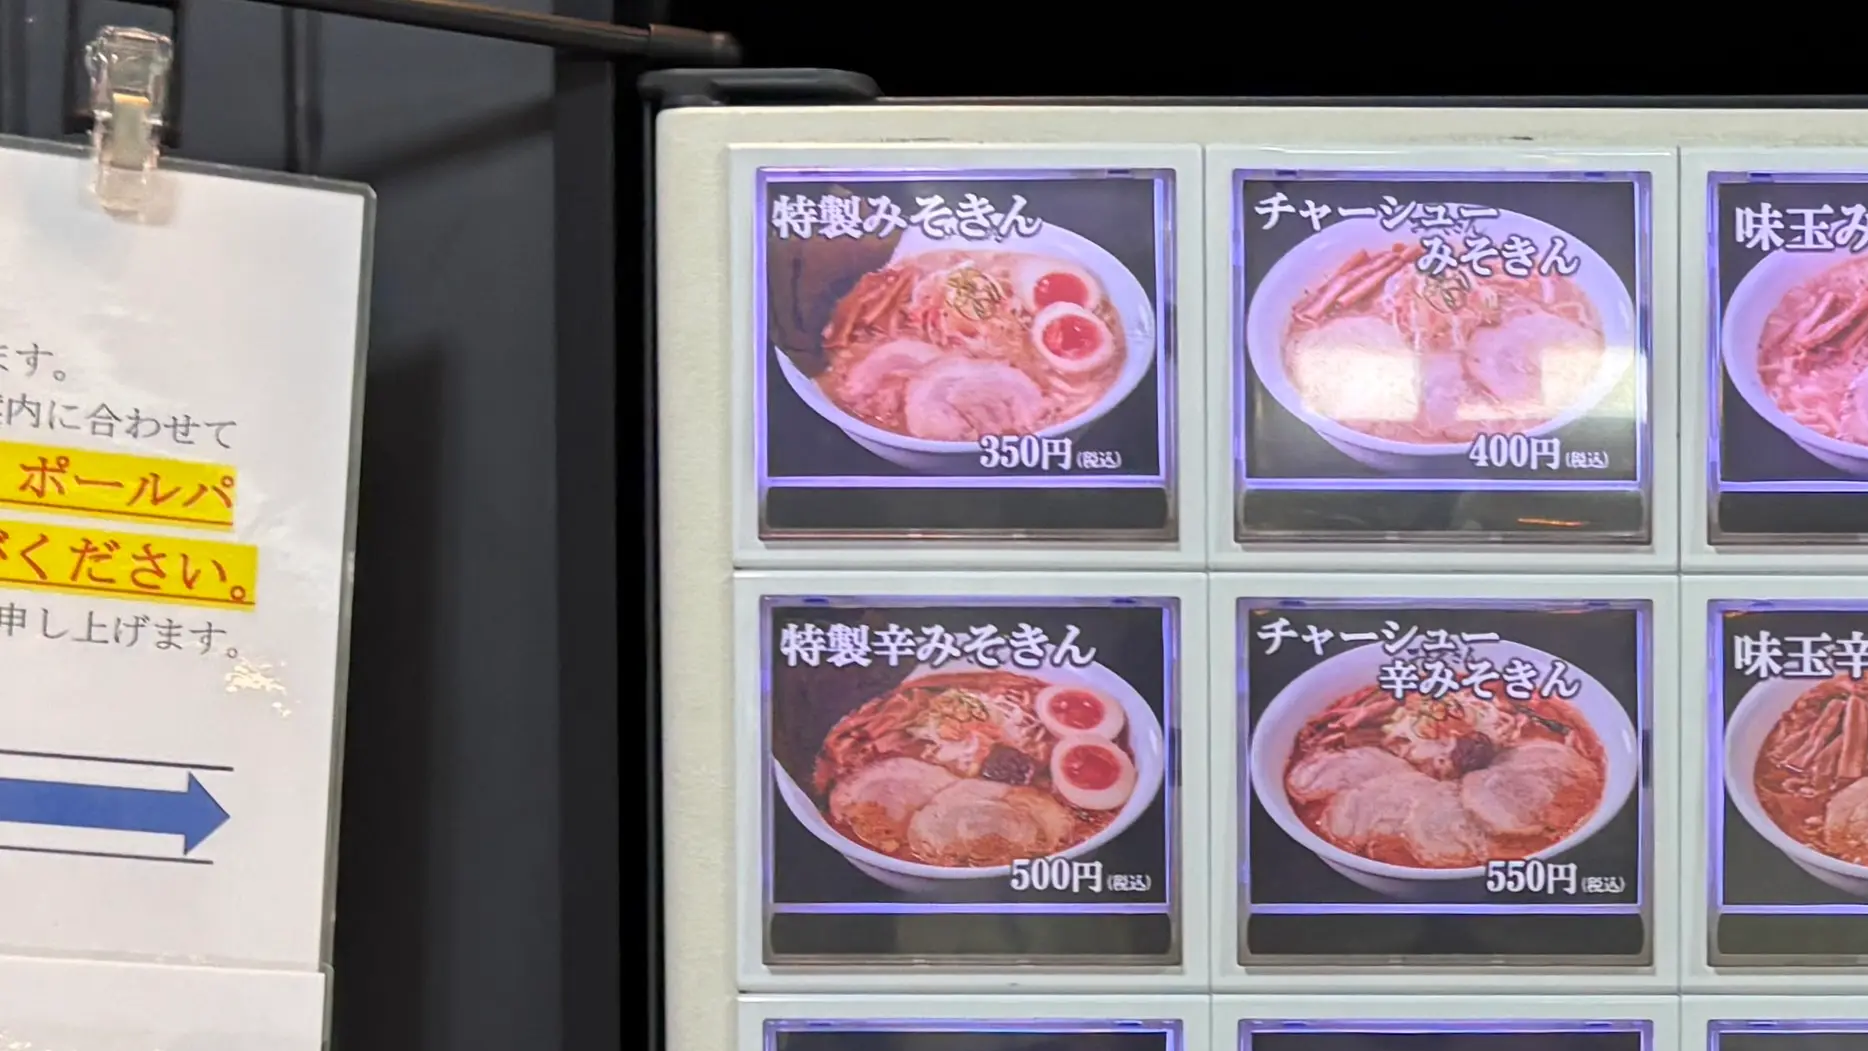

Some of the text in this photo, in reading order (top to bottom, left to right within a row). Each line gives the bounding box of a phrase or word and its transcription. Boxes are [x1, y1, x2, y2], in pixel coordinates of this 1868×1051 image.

[772, 193, 1041, 239] 特製みそきん
[1254, 192, 1499, 230] チャーシュー
[1417, 236, 1580, 276] みそきん
[0, 342, 66, 381] す。
[0, 393, 237, 449] 内に合わせて
[19, 456, 235, 509] ポールパ
[0, 530, 246, 603] ください。
[780, 624, 1096, 667] 特製辛みそきん
[1257, 618, 1500, 656] チャーシュー
[1379, 661, 1580, 698] 辛みそきん
